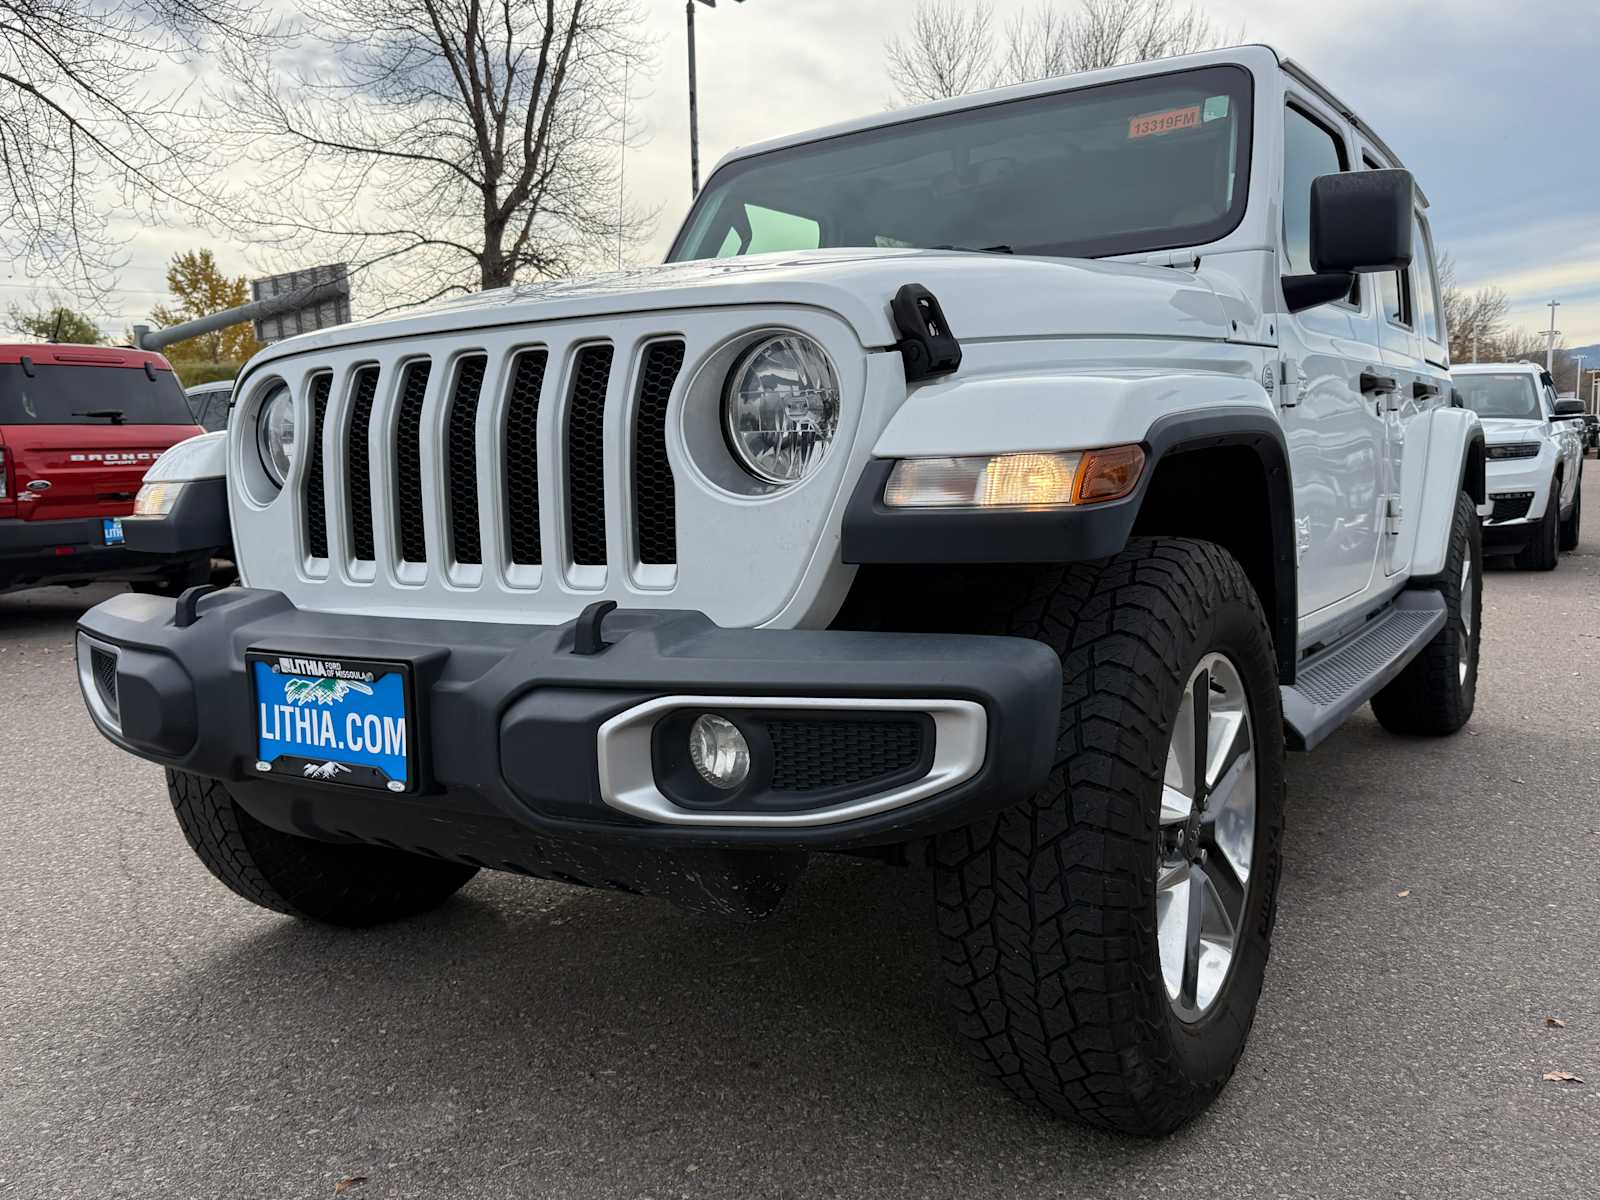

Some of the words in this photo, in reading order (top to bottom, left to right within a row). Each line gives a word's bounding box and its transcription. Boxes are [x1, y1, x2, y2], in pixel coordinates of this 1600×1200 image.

[1135, 112, 1195, 134] 13319FM
[289, 658, 327, 677] LITHIA
[325, 662, 341, 671] FORD
[326, 669, 335, 678] OF
[335, 670, 367, 680] MISSOULA
[261, 703, 406, 756] LITHIA.COM
